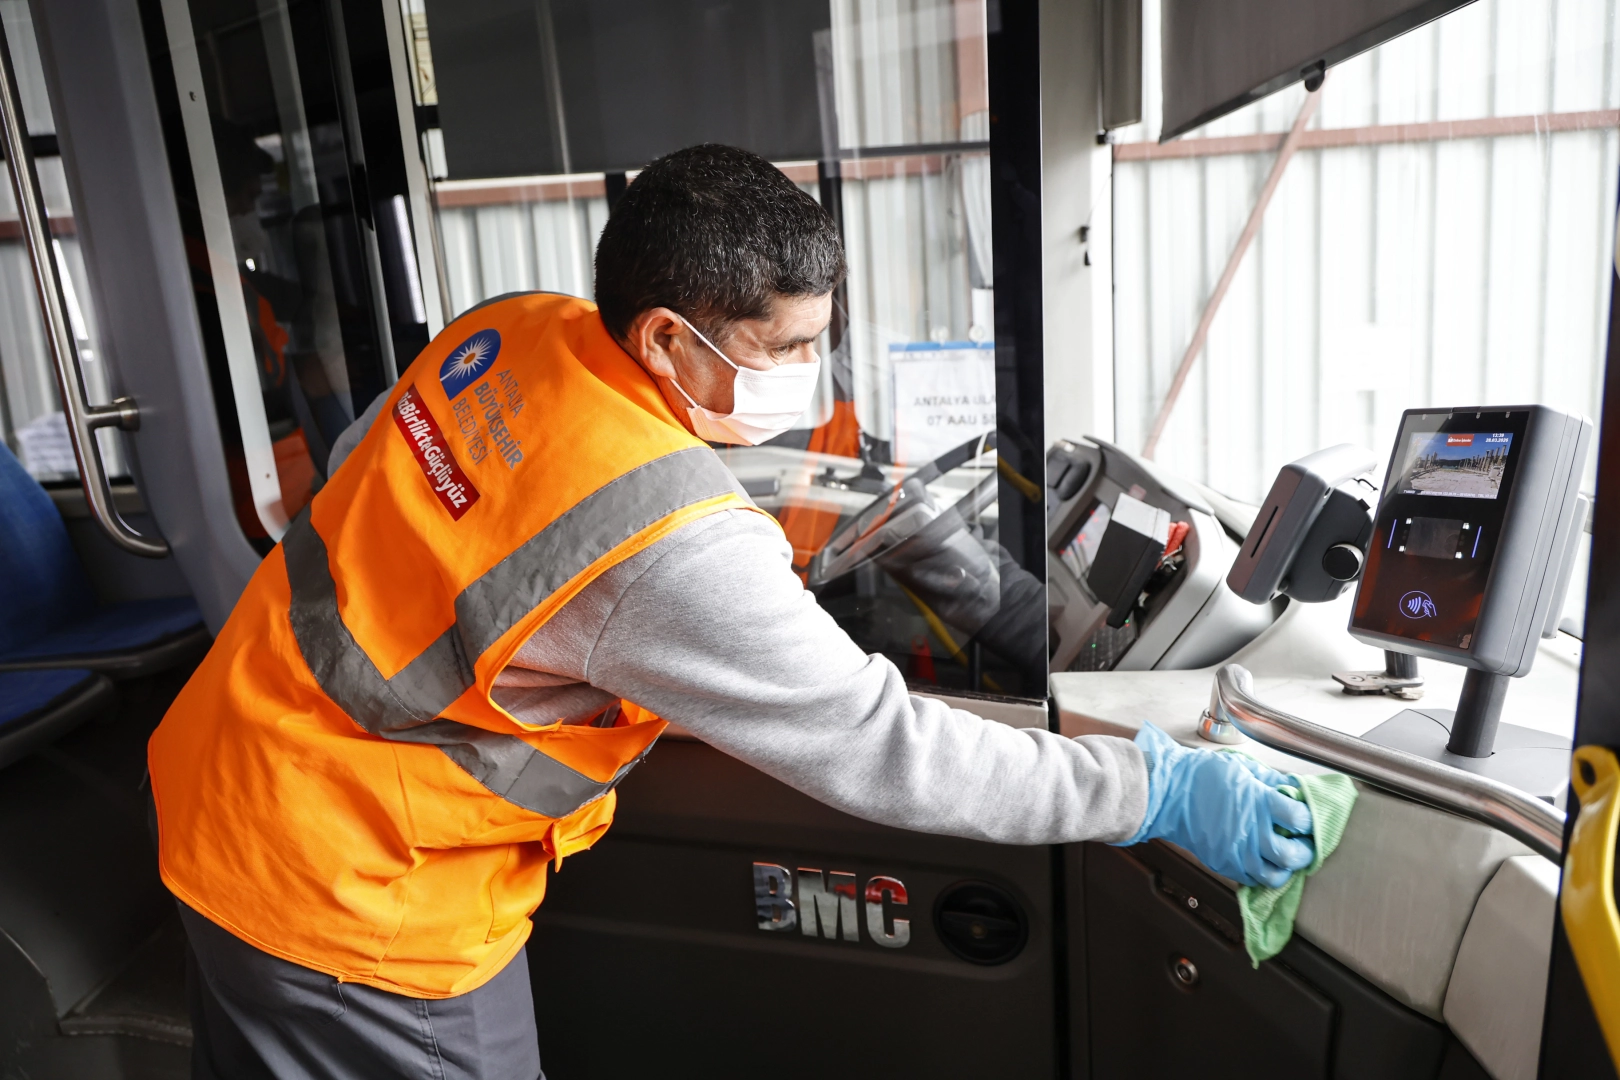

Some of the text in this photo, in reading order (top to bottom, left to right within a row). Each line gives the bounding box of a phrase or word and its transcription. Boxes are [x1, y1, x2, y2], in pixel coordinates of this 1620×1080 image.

[474, 381, 524, 470] BÜYÜKŞEHİR
[496, 369, 526, 419] ANTALYA
[914, 395, 970, 407] ANTALYA
[453, 397, 493, 466] BELEDİYESİ
[753, 862, 910, 948] BMC
